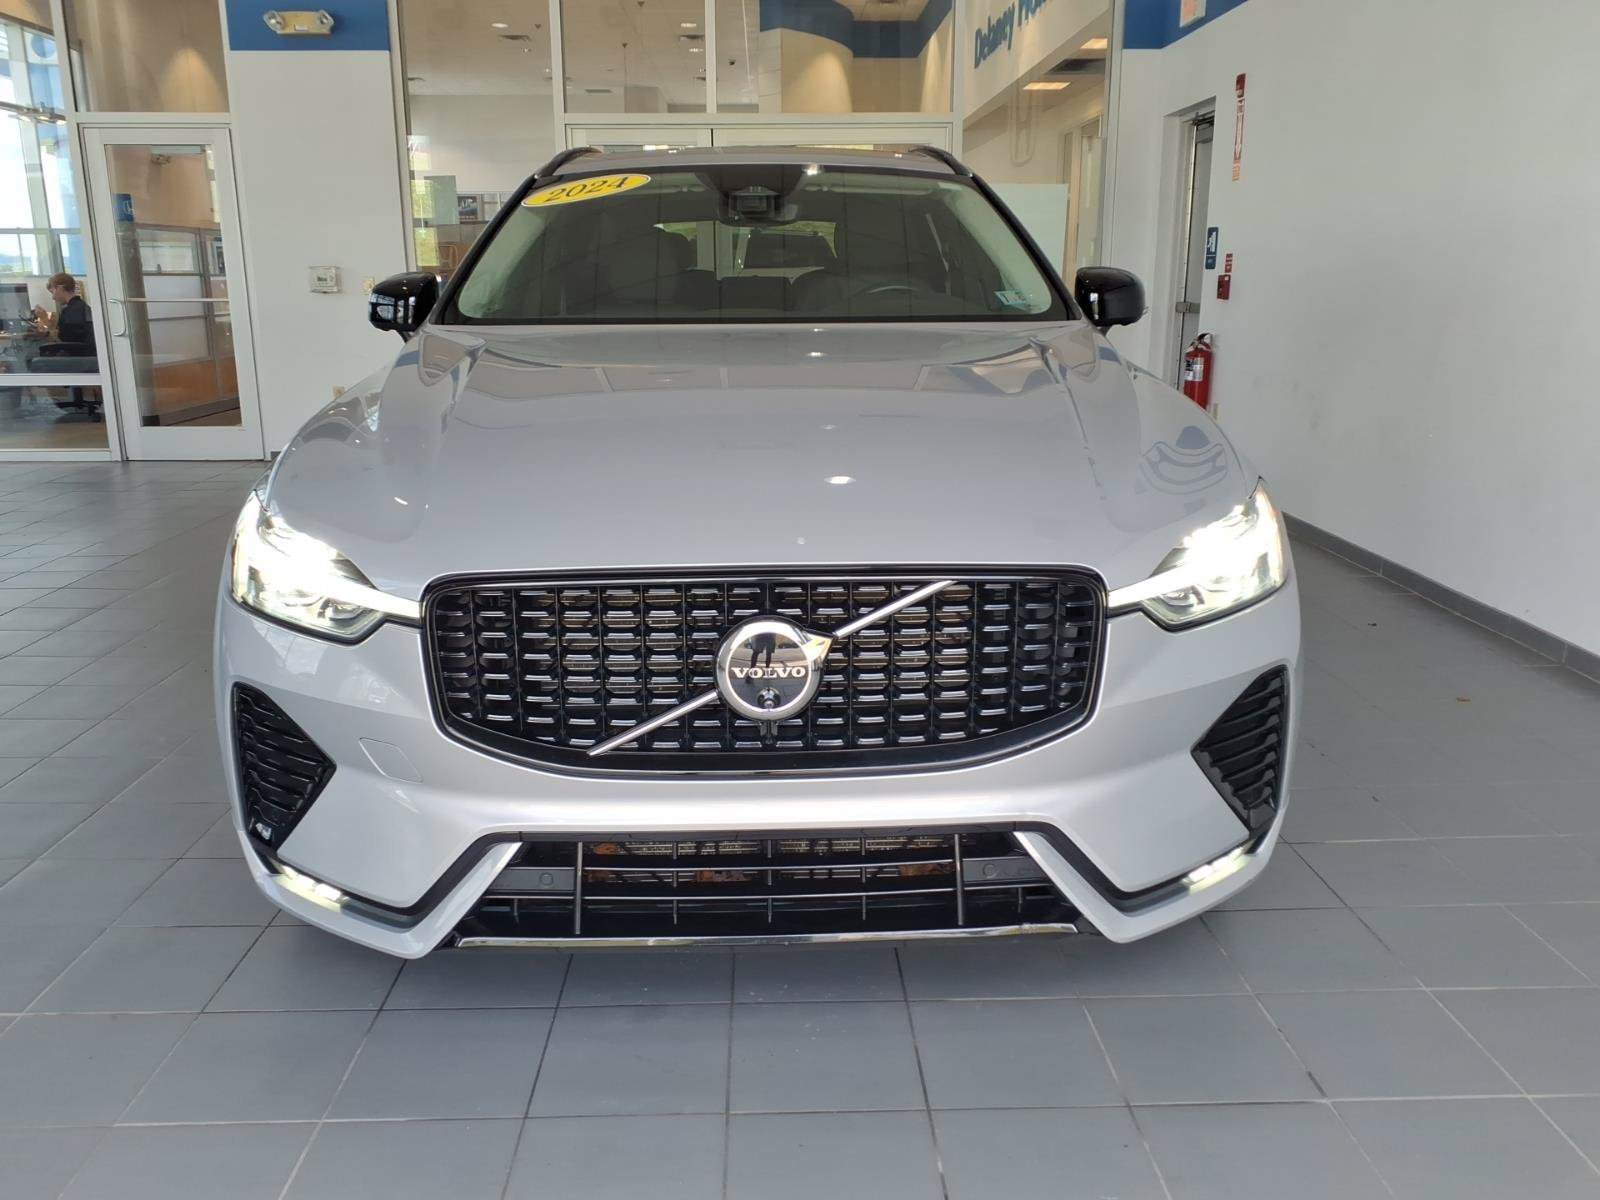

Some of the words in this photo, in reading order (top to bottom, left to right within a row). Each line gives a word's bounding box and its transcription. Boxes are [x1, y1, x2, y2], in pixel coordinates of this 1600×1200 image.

[974, 1, 1015, 69] Delaney
[543, 176, 629, 203] 2024
[731, 666, 806, 679] VOLVO
